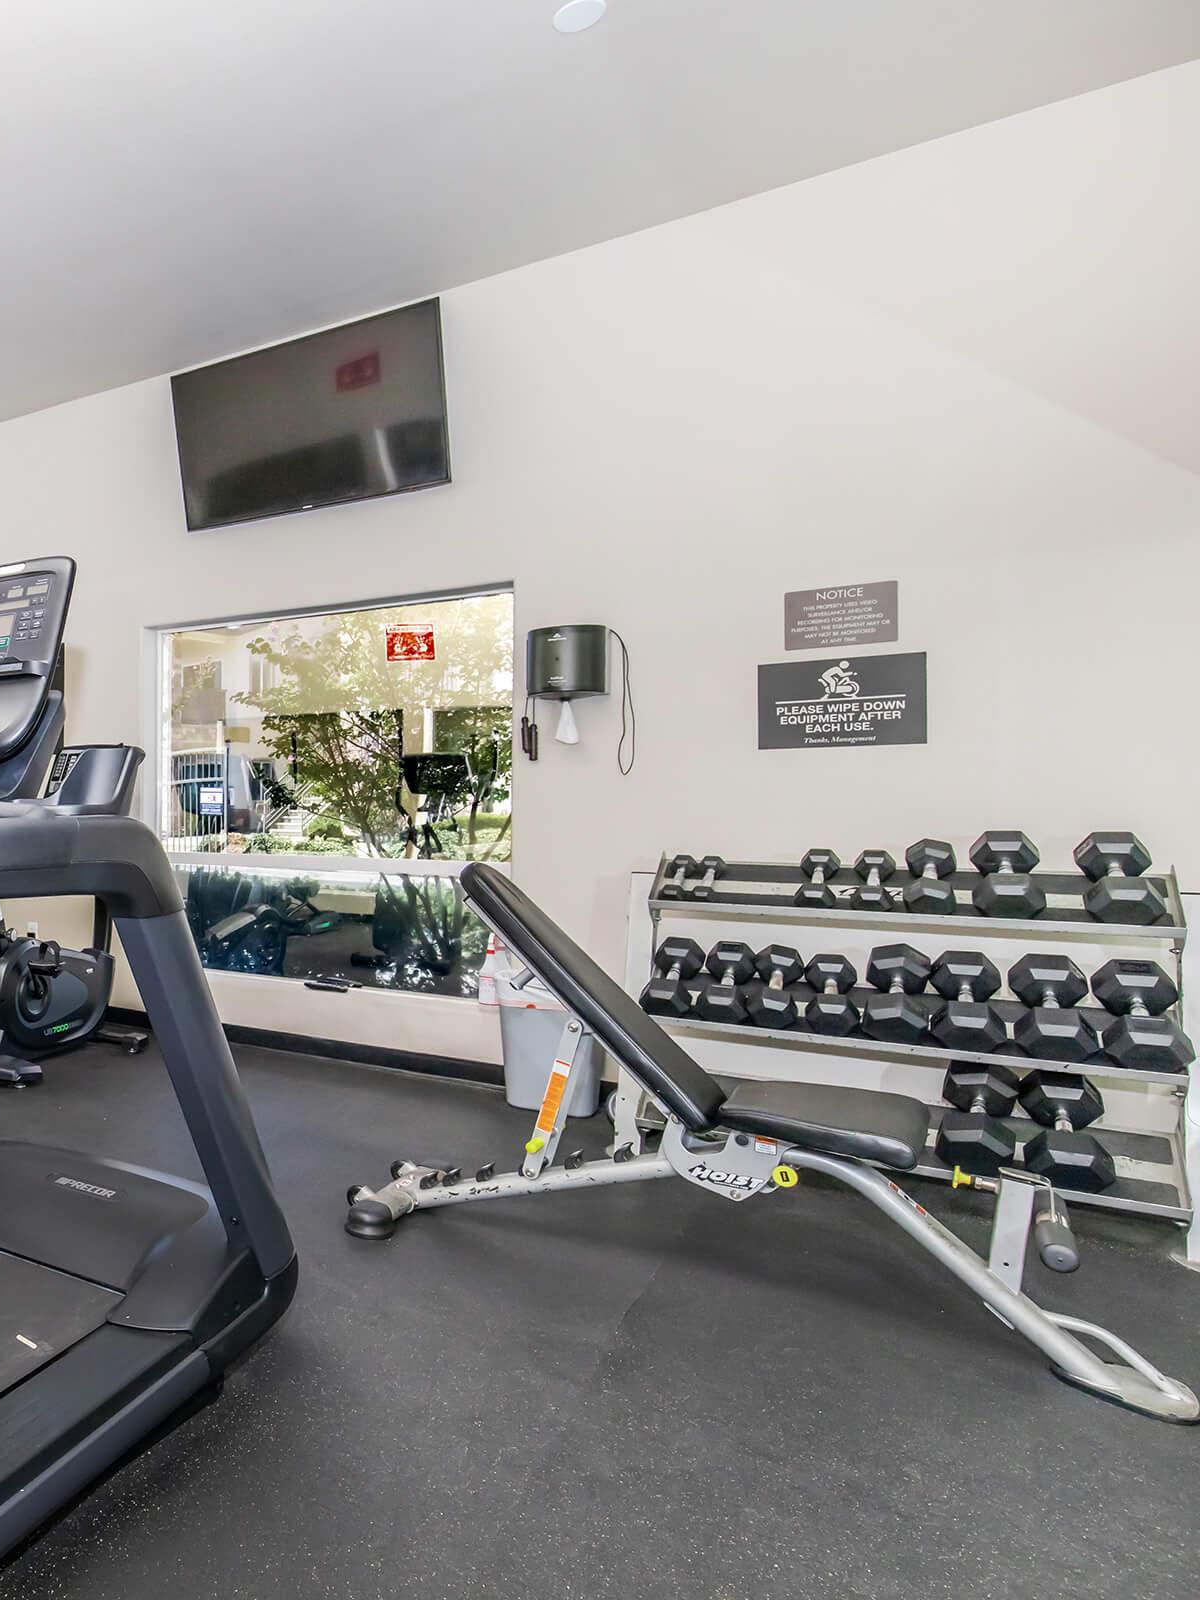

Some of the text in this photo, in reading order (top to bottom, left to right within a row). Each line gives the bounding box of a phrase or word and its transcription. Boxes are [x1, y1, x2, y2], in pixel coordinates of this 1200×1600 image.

[816, 587, 864, 601] NOTICE
[776, 700, 906, 716] PLEASE WIPE DOWN
[780, 710, 902, 726] EQUIPMENT AFTER
[805, 722, 874, 733] EACH USE.
[689, 1165, 764, 1189] HOIST
[62, 1177, 117, 1198] PRECOR
